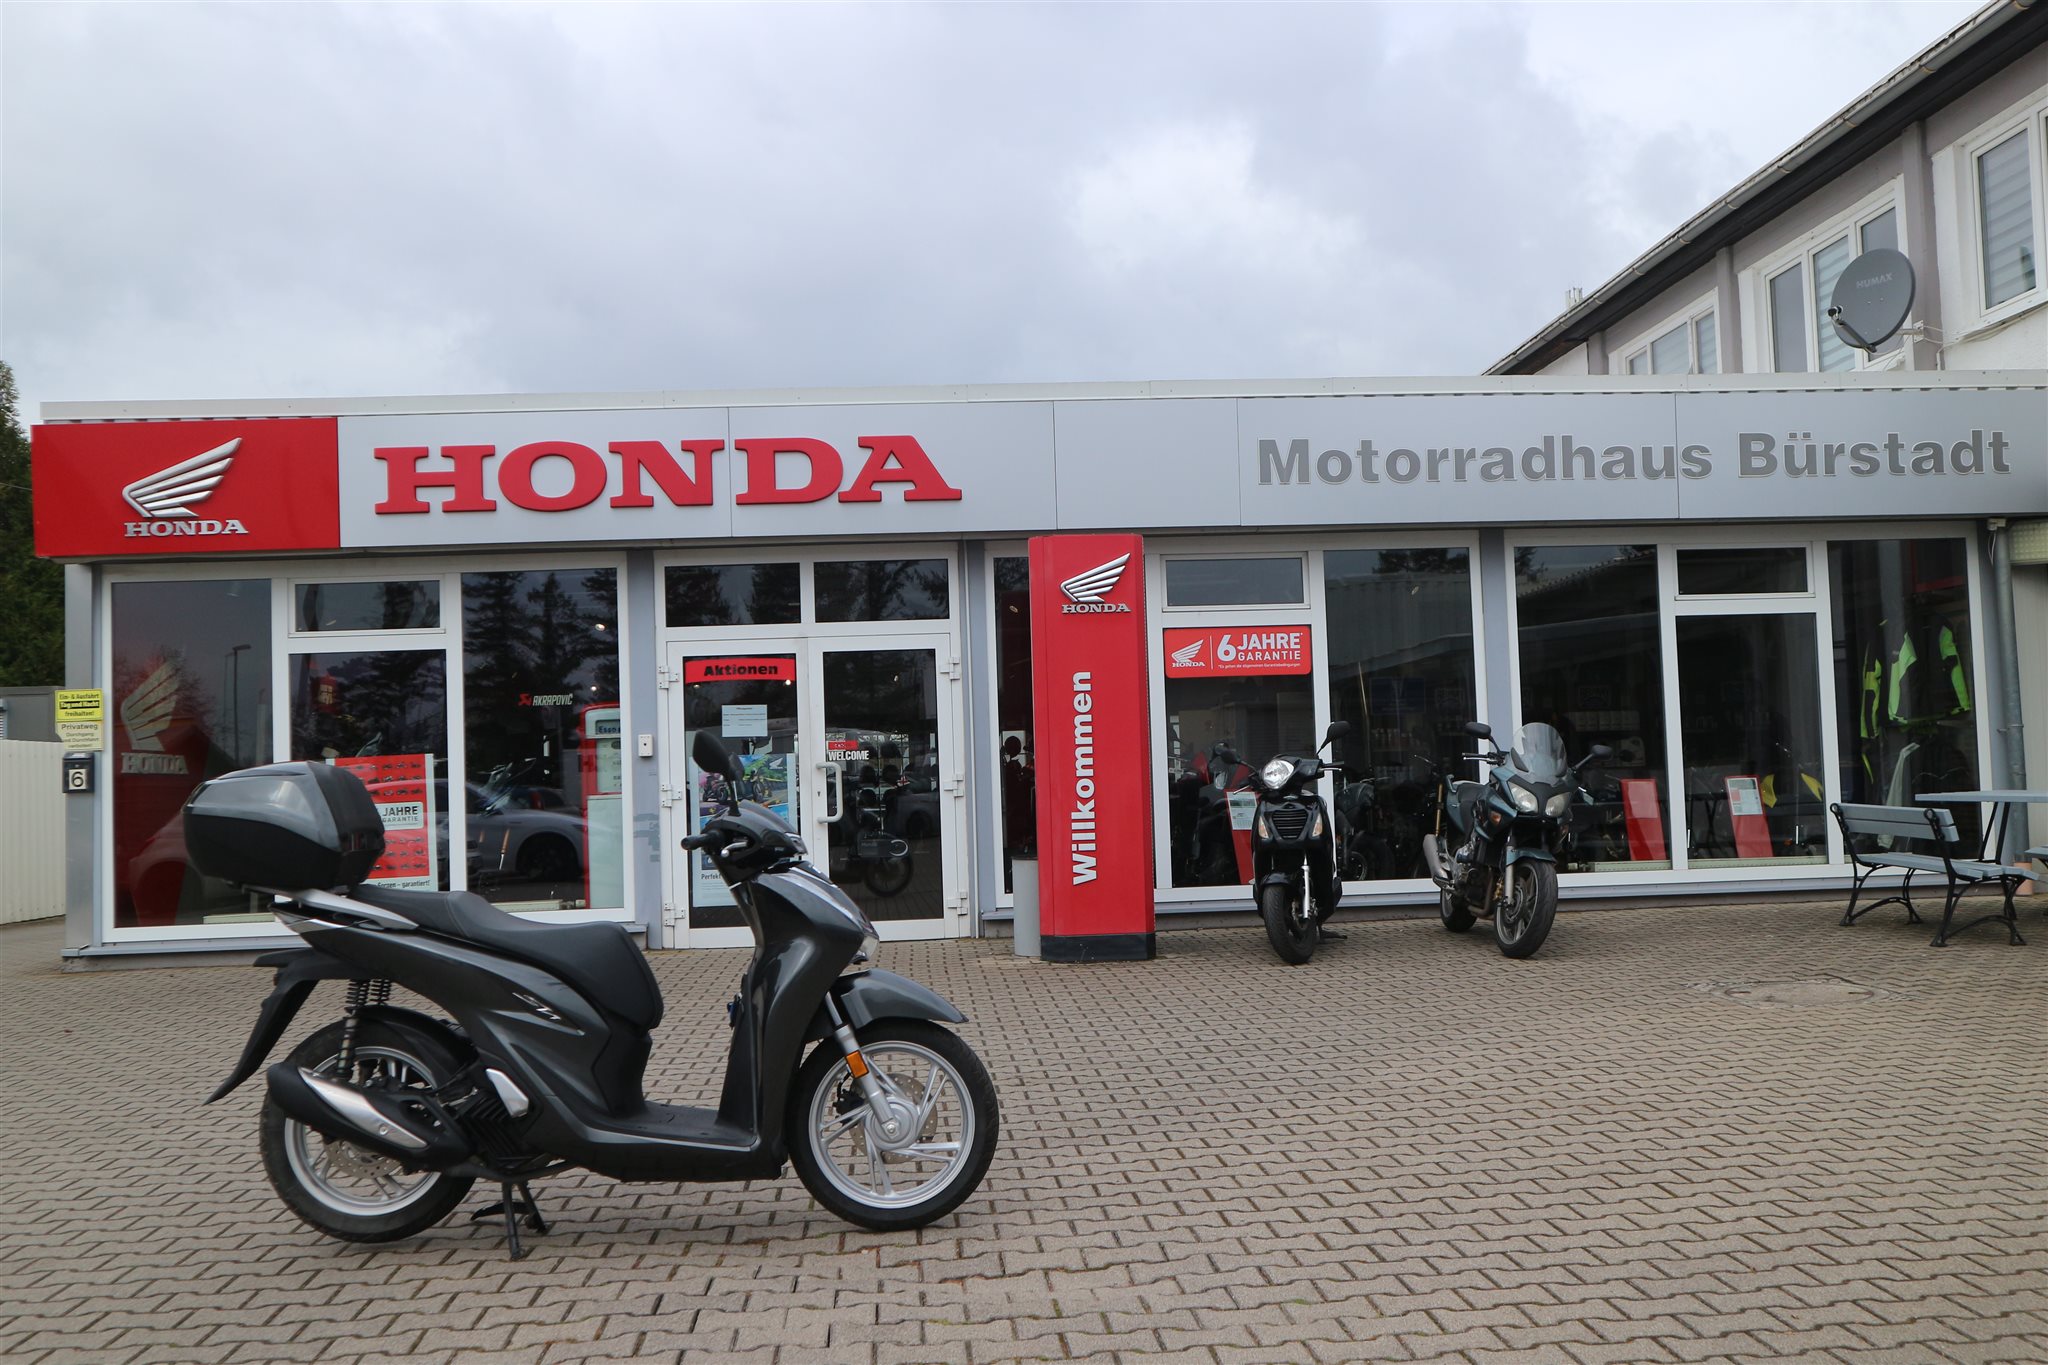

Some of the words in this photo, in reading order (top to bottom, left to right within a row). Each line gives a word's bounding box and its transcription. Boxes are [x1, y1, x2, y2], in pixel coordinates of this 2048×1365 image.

[1856, 272, 1893, 289] HUMAX
[1257, 433, 1714, 486] Motorradhaus
[1736, 428, 2012, 480] Bürstadt
[374, 435, 963, 515] HONDA
[124, 518, 249, 538] HONDA
[1061, 602, 1132, 615] HONDA
[1216, 634, 1237, 662] 6
[1237, 650, 1301, 662] GARANTIE
[703, 664, 779, 677] Aktionen
[61, 723, 98, 731] Privatweg
[121, 752, 189, 775] HONDA
[828, 750, 870, 761] WELCOME
[71, 771, 84, 788] 6
[1070, 671, 1098, 886] Willkommen
[382, 805, 418, 817] JAHRE
